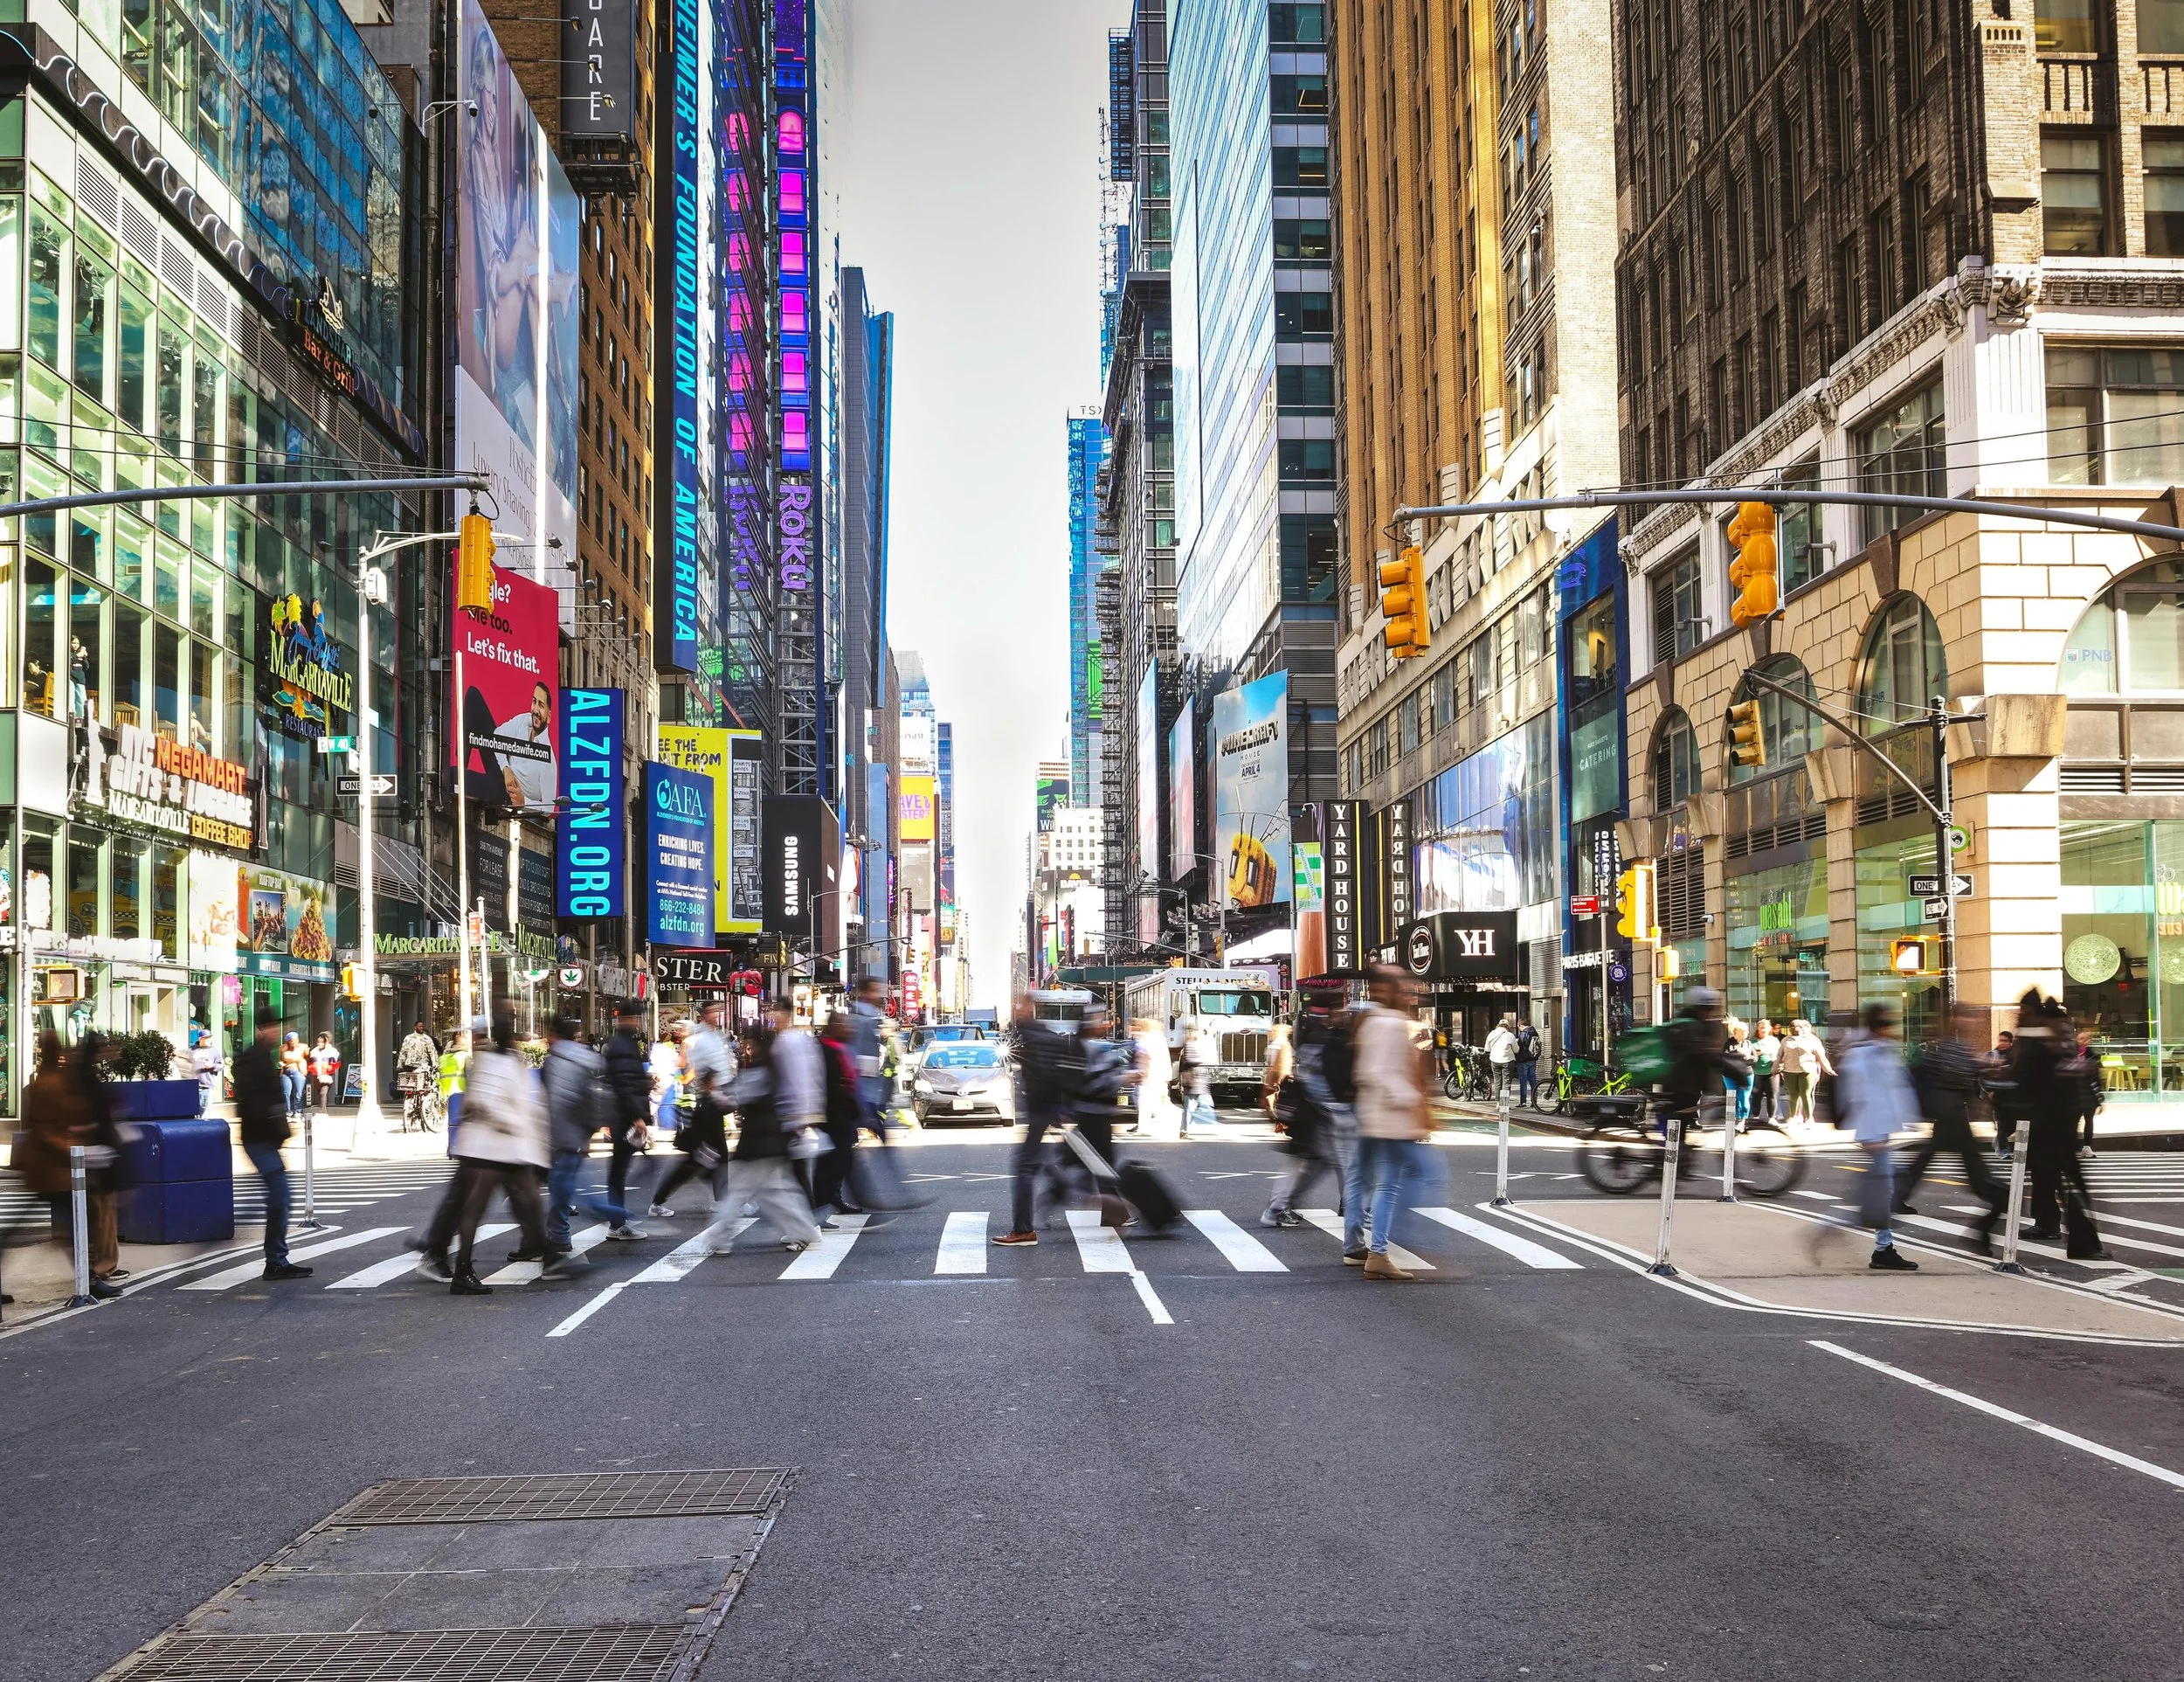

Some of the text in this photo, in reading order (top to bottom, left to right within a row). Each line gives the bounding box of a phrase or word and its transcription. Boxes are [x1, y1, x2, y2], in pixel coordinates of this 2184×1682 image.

[676, 173, 696, 399] FOUNDATION
[304, 329, 355, 397] Bar & Grill
[675, 418, 695, 464] OF
[473, 441, 502, 502] Luxury
[779, 485, 812, 589] ROKU
[675, 482, 695, 640] AMERICA
[468, 609, 513, 635] Me too.
[467, 631, 540, 675] Let's fix that.
[2082, 649, 2112, 661] PNB
[285, 713, 326, 739] RESTAURANT
[1220, 720, 1279, 758] MINECRAFT
[328, 738, 335, 750] W
[337, 737, 349, 750] 40
[469, 732, 549, 759] findmohamedawife.com
[674, 738, 697, 751] THE
[1241, 750, 1261, 762] MOVIE
[156, 738, 245, 795] MEGAMART
[686, 753, 722, 766] FROM
[1241, 764, 1261, 778] APRIL 4
[1579, 744, 1616, 771] CATERING
[570, 689, 611, 917] ALZFDN.ORG
[668, 783, 705, 817] AFA
[191, 814, 225, 841] COFFEE
[228, 823, 253, 850] SHOP
[658, 834, 706, 855] ENRICHING LIVES.
[480, 857, 503, 878] FOR LEASE
[660, 852, 704, 871] CREATING HOPE.
[784, 835, 799, 917] SAMSUNG
[1333, 805, 1349, 968] YARD HOUSE
[660, 898, 705, 916] 866-232-8484
[660, 915, 705, 938] alzfdn.org
[1455, 930, 1495, 956] YH
[1561, 949, 1614, 970] PARIS BAGUETE
